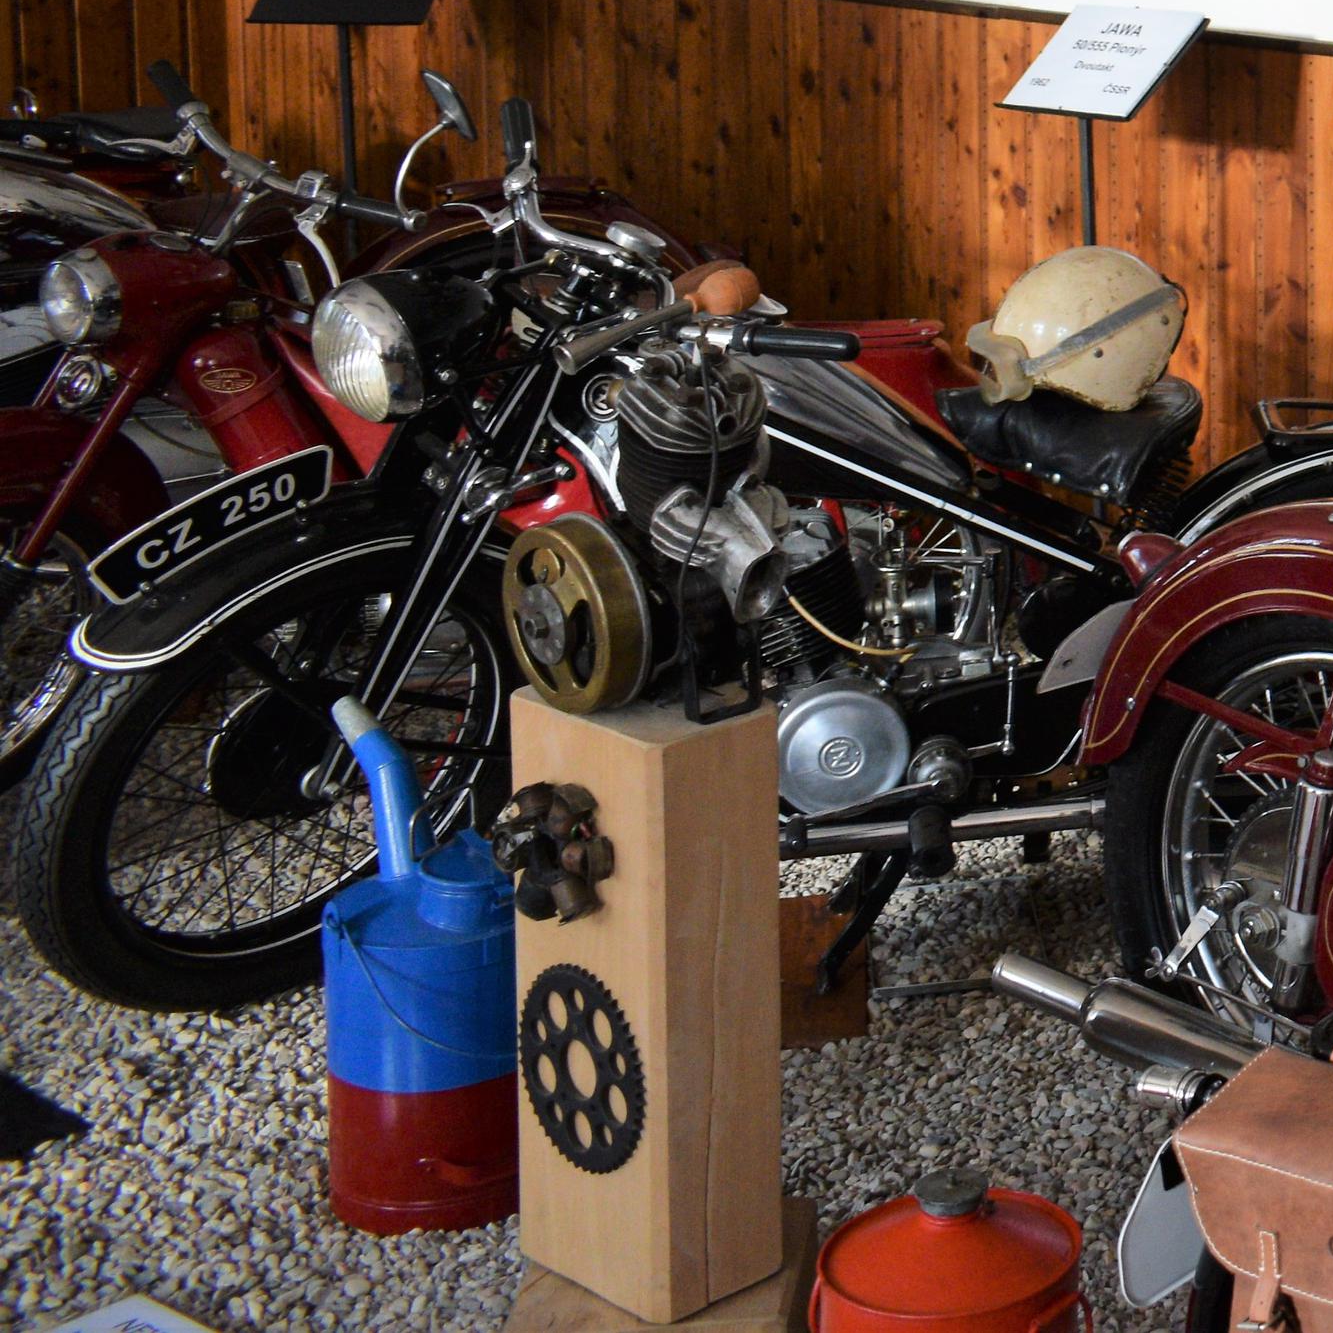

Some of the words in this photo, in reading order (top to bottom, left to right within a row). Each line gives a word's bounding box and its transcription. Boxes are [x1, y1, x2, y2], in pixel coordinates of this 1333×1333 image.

[1101, 22, 1143, 37] JAWA
[135, 518, 203, 570] CZ
[219, 472, 296, 527] 250
